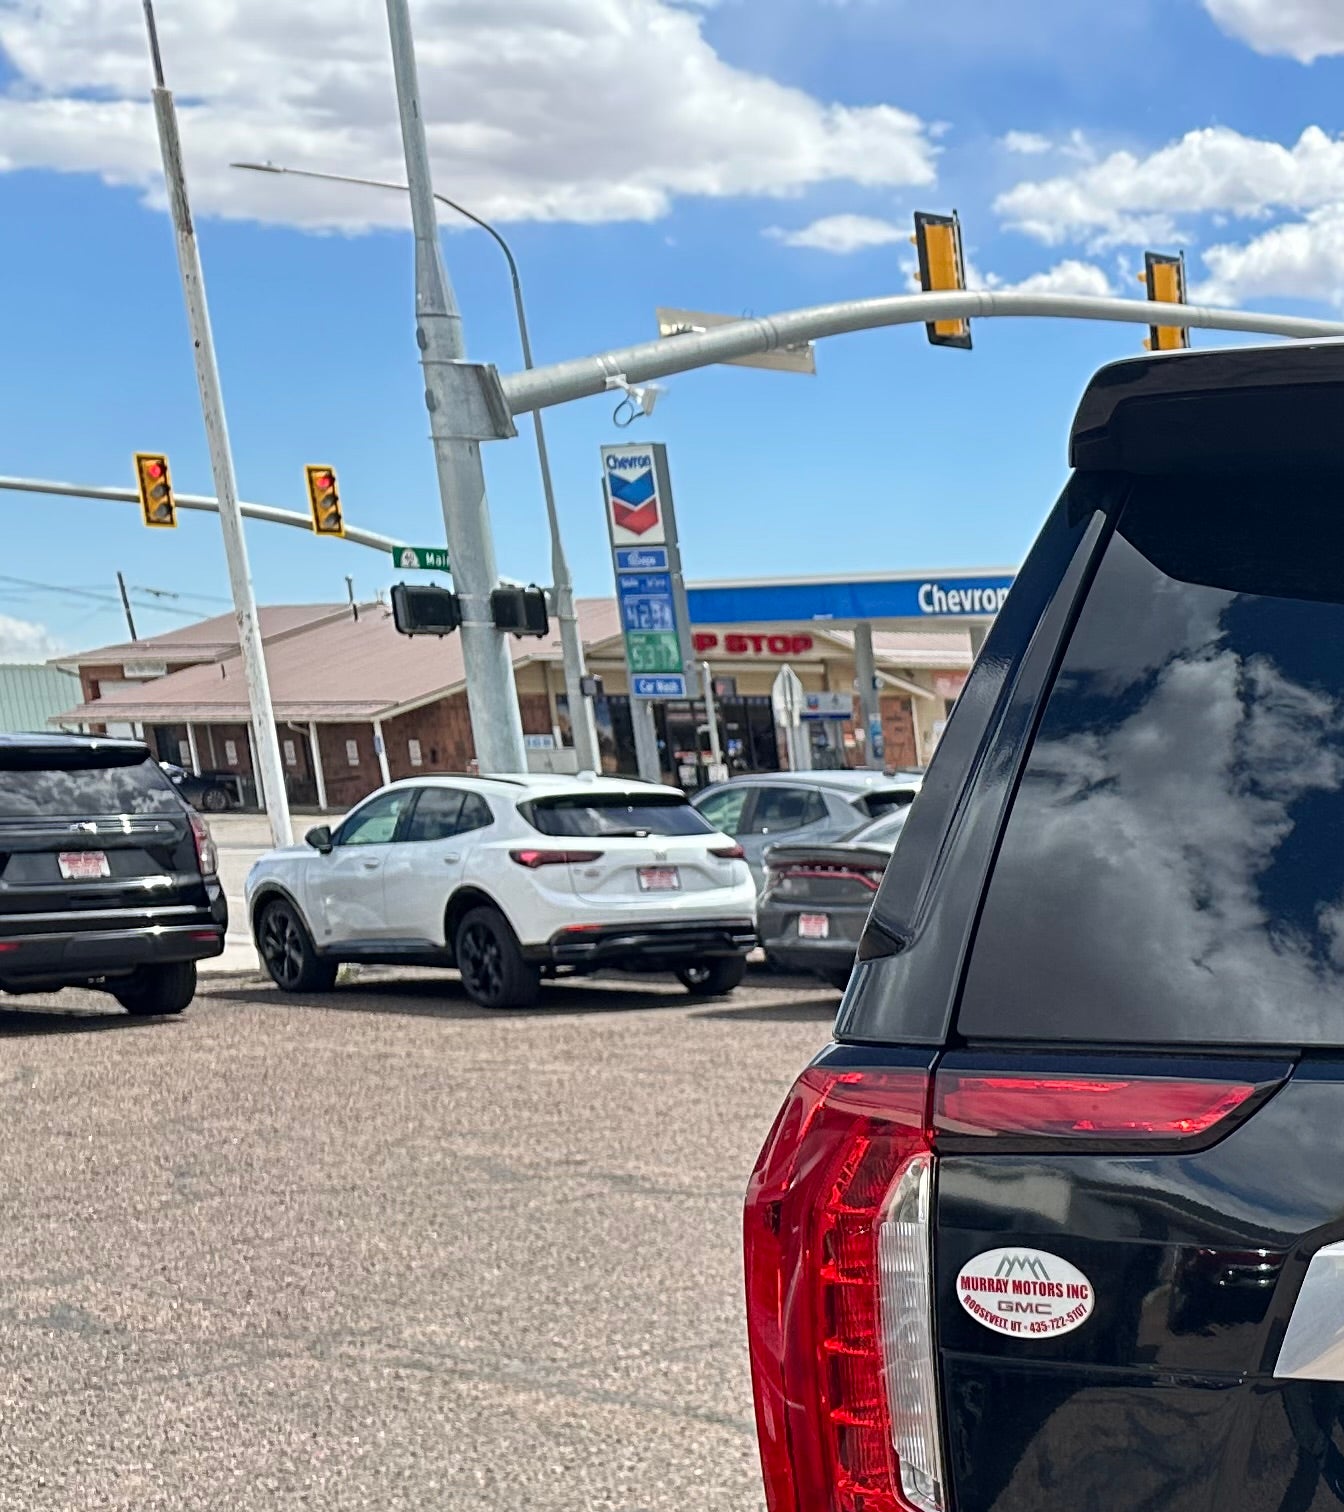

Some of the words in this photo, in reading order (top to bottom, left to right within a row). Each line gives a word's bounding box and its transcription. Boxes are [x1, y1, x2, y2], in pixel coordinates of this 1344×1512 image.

[606, 454, 652, 470] Chevron
[724, 632, 813, 655] STOP
[960, 1275, 1008, 1293] MURRAY
[1012, 1280, 1064, 1298] MOTORS
[1066, 1283, 1089, 1300] INC
[998, 1300, 1052, 1315] GMC
[1010, 1320, 1022, 1332] UT
[1029, 1303, 1088, 1333] 435-722-5107
